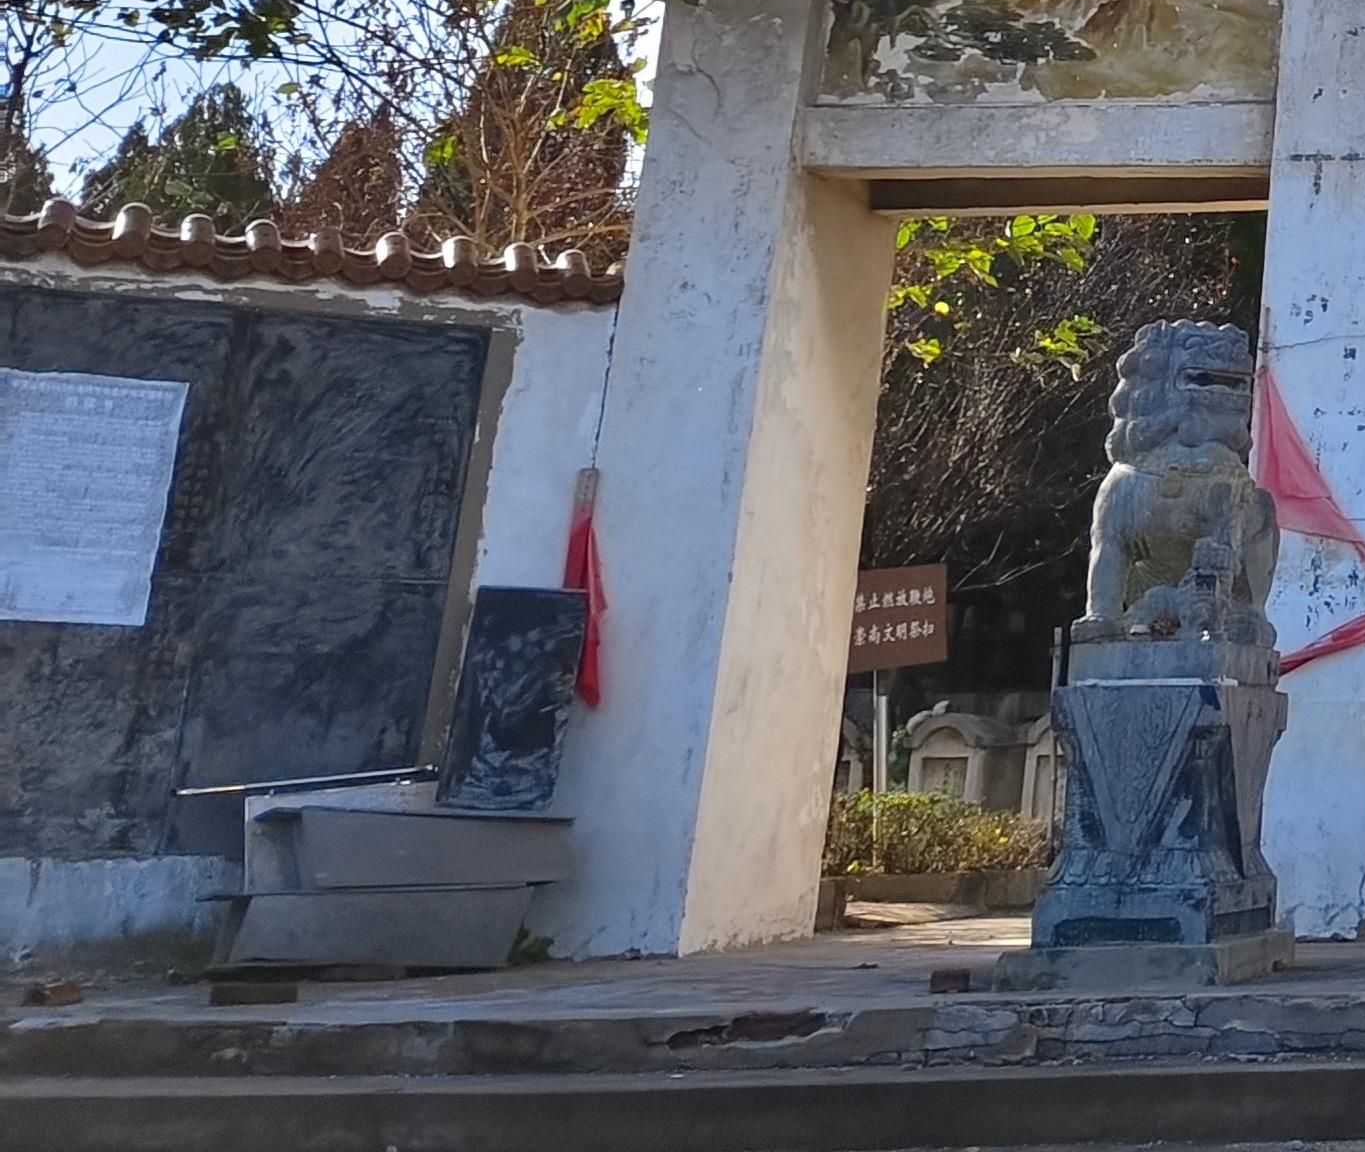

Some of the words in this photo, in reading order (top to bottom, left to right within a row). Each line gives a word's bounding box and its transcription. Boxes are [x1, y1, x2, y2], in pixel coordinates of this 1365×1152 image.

[855, 586, 936, 613] 禁止燃放鞭炮
[854, 619, 935, 646] 崇尚文明祭扫
